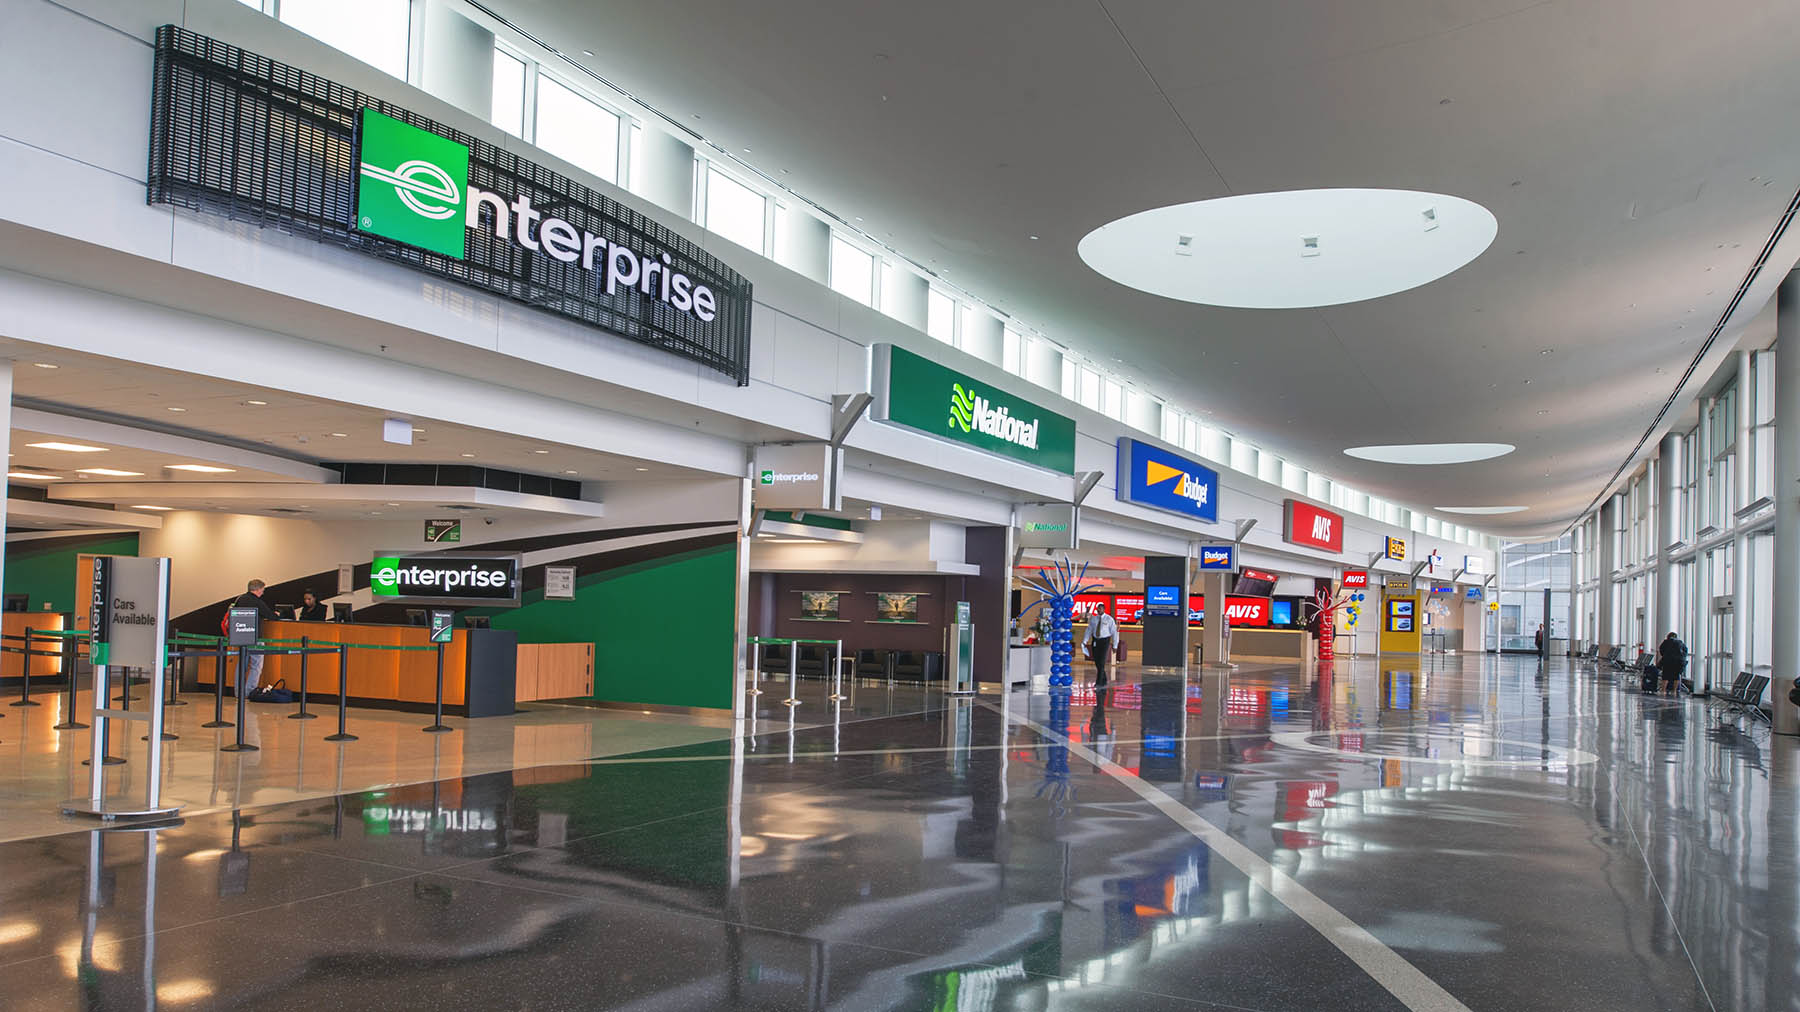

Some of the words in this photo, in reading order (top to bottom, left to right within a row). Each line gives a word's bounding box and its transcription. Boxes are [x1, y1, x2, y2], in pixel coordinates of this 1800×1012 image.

[361, 160, 716, 322] enterprise
[971, 396, 1039, 449] National
[762, 472, 819, 483] enterprise
[1183, 472, 1208, 508] Budget
[1034, 523, 1067, 532] National
[1312, 514, 1331, 543] AVIS
[1204, 551, 1228, 561] Budget
[370, 564, 506, 592] enterprise
[1345, 575, 1365, 583] AVIS
[91, 558, 104, 658] enterprise
[113, 598, 135, 610] Cars
[1225, 605, 1261, 619] AVIS
[112, 613, 156, 626] Available
